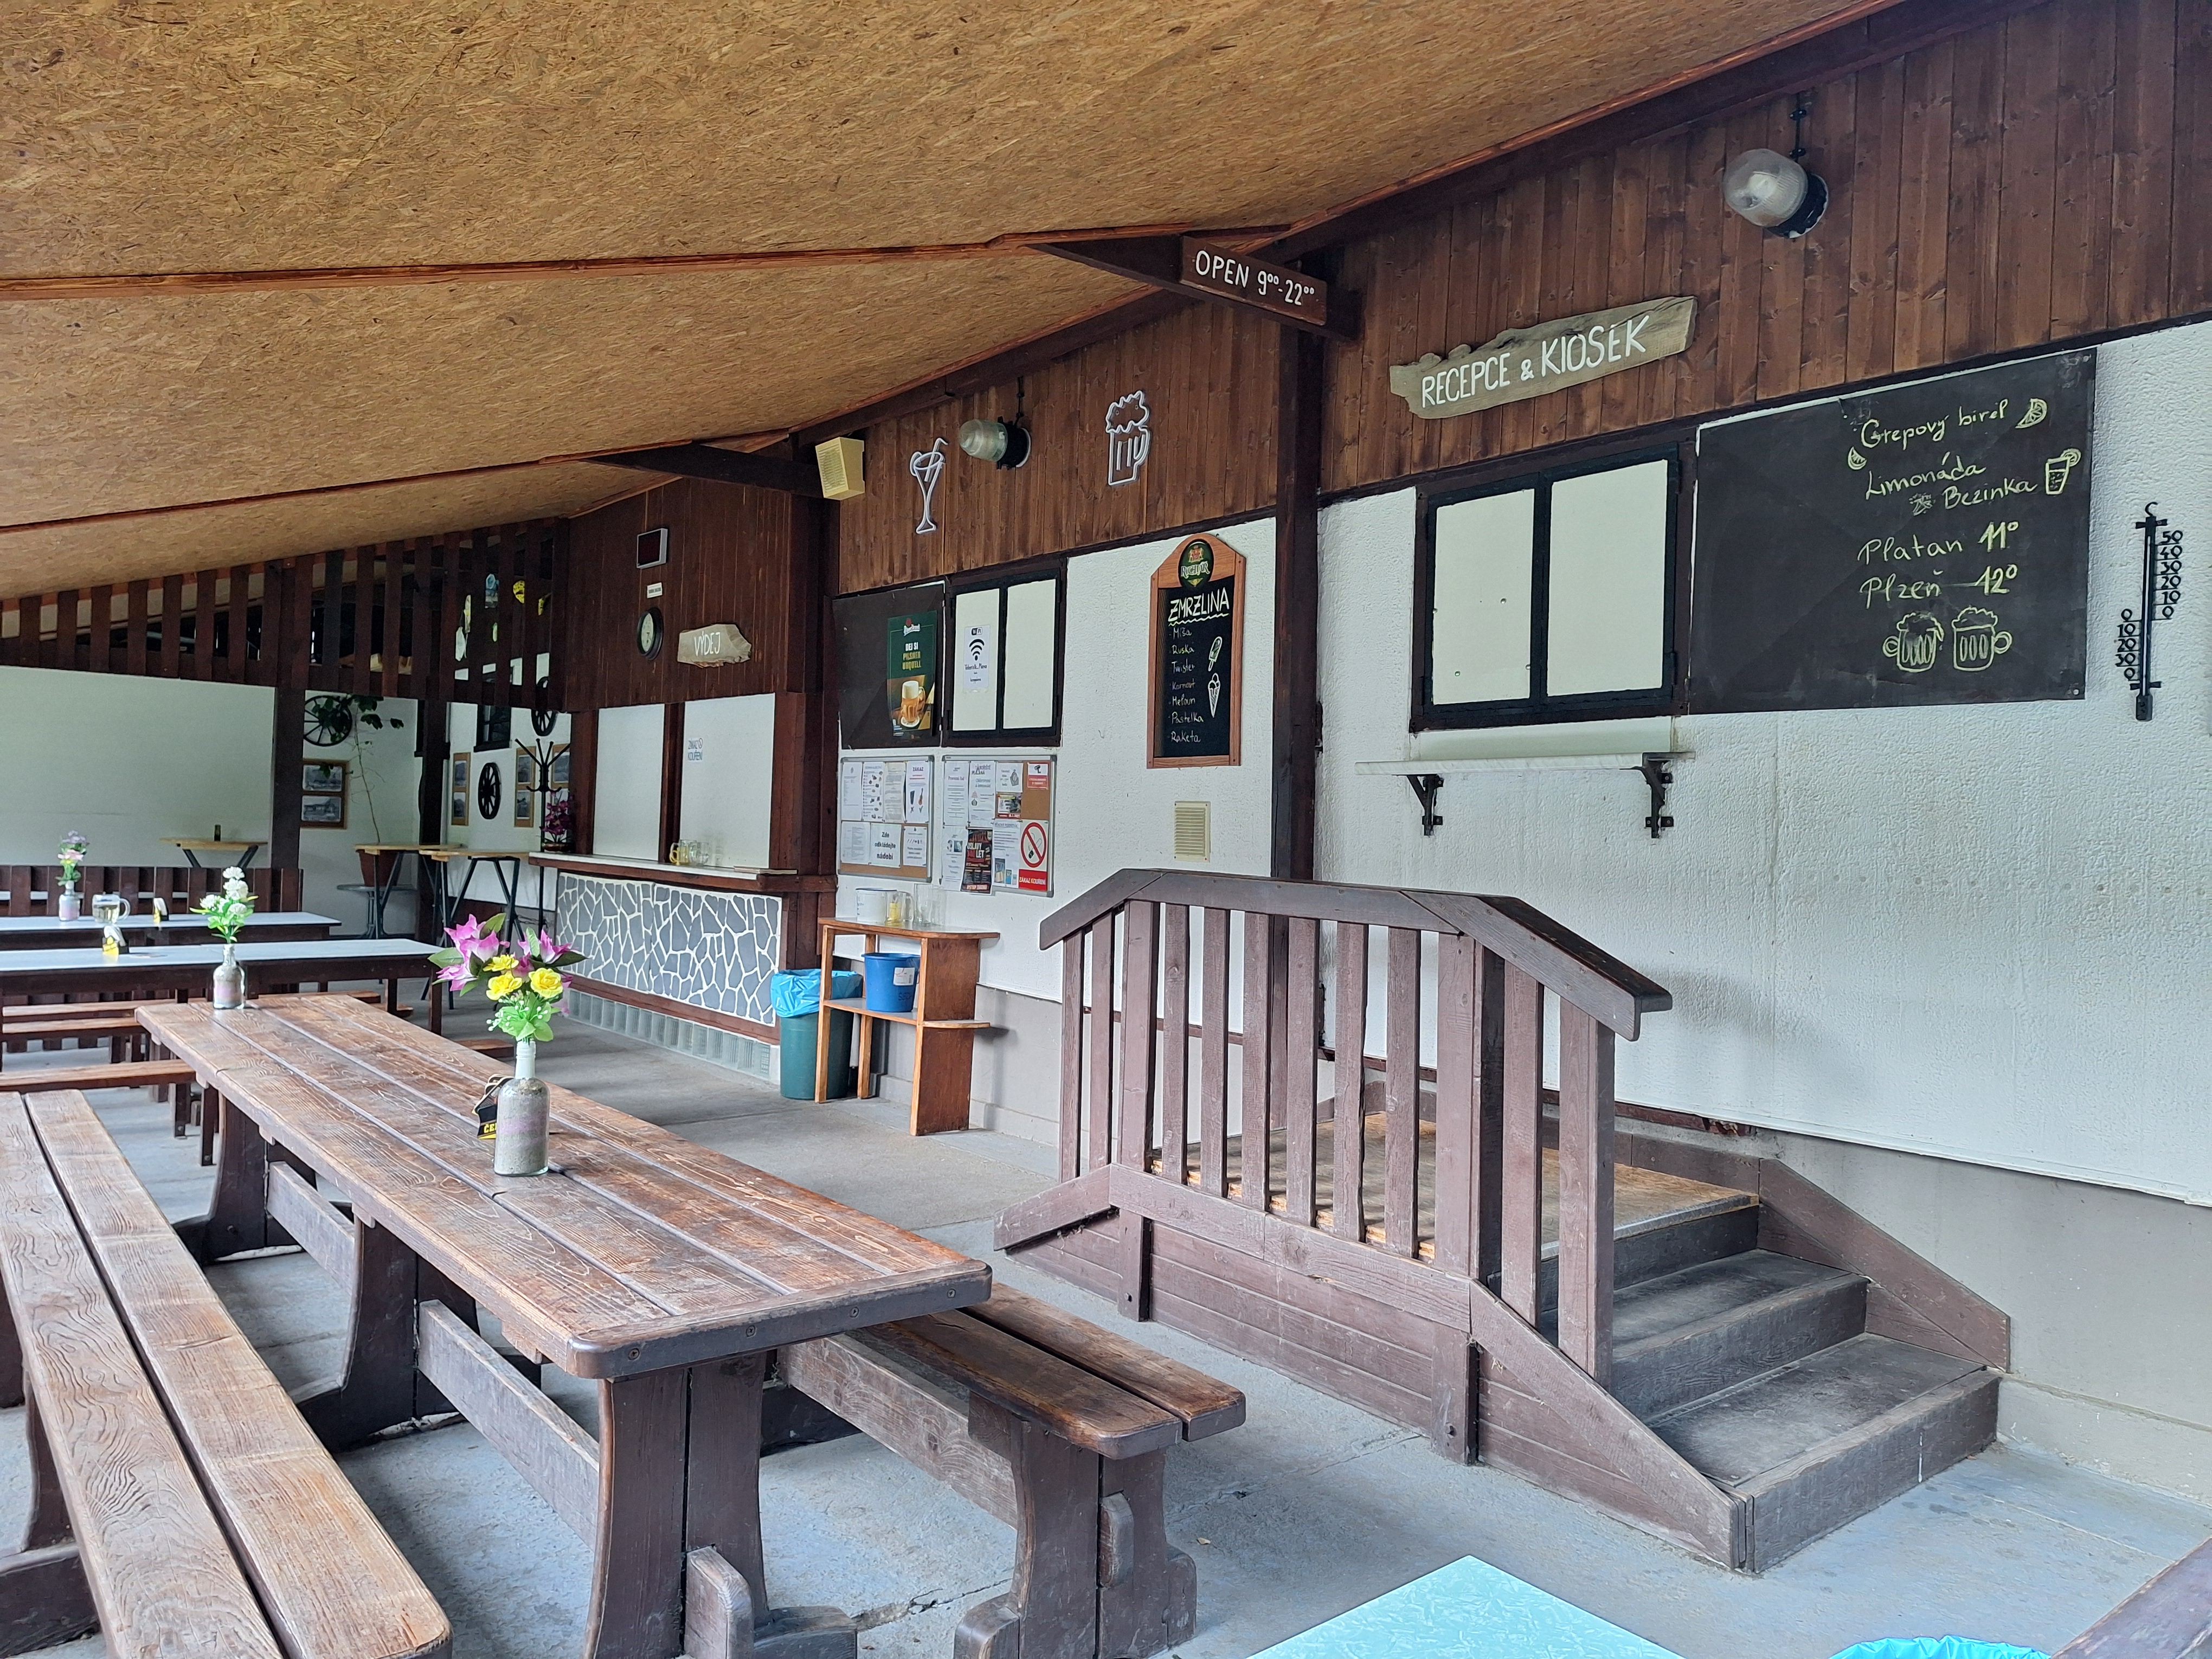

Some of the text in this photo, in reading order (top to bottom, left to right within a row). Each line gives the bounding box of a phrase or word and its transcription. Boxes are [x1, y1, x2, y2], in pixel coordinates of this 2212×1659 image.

[1195, 250, 1249, 288] OPEN
[1422, 315, 1650, 408] RECEPCE & KIOSEK
[1861, 414, 1950, 450] Grepový
[1866, 452, 1986, 500] Limonáda
[1943, 478, 2039, 509] Bezinka
[2161, 530, 2183, 544] 50
[1857, 534, 1963, 564] Platan
[2160, 545, 2183, 559] 40
[2160, 560, 2182, 574] 30
[1859, 569, 1942, 608] Plzeň
[2161, 575, 2181, 589] 20
[1168, 587, 1230, 621] ZMRZLINA
[2162, 590, 2181, 604] 10
[2121, 609, 2132, 621] 0
[2162, 606, 2174, 619] 0
[2117, 623, 2136, 637] 10
[694, 631, 720, 656] VÝDEJ
[914, 642, 918, 650] SI
[2117, 638, 2136, 652] 20
[2114, 653, 2136, 666] 30
[1172, 711, 1204, 724] Pastelka
[1171, 730, 1201, 743] Raketa
[976, 850, 985, 858] LET
